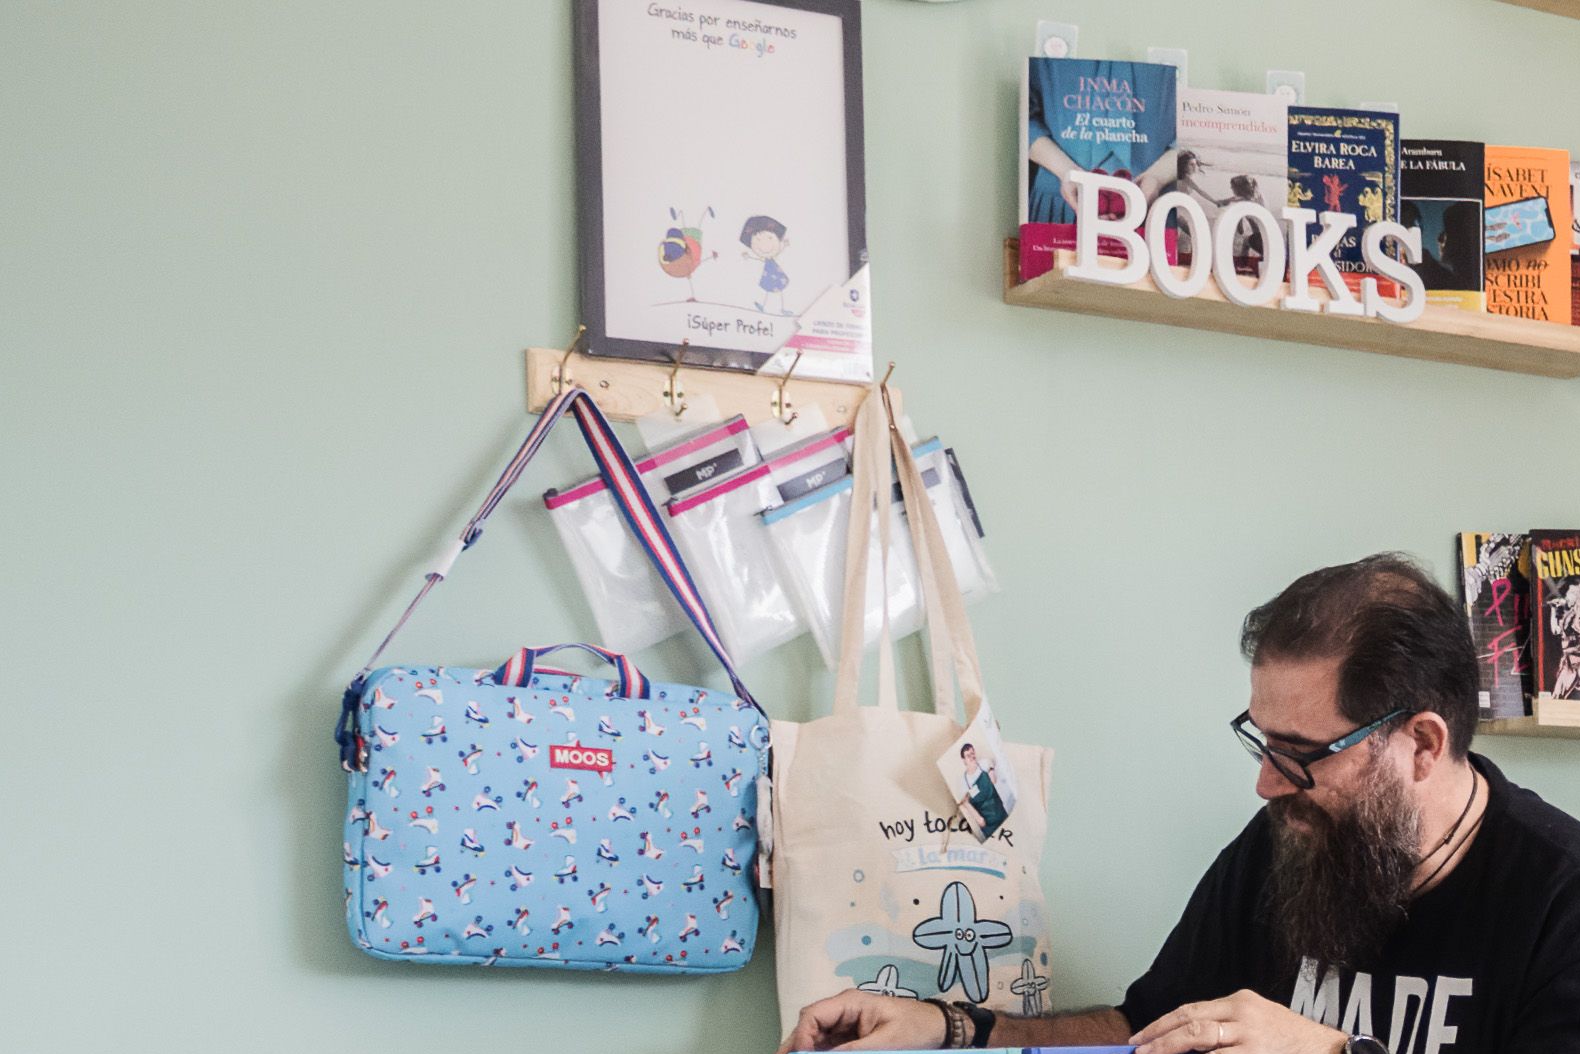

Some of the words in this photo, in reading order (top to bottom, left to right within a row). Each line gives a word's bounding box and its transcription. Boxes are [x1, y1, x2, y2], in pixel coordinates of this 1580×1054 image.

[647, 2, 695, 22] Gracias
[699, 14, 720, 31] por
[726, 19, 798, 40] enseñarnos
[671, 28, 698, 42] más
[702, 33, 724, 49] que
[1079, 76, 1132, 94] INMA
[1182, 102, 1214, 116] Pedro
[1074, 113, 1090, 127] El
[1091, 116, 1136, 129] cuarto
[1060, 124, 1078, 139] de
[1079, 123, 1094, 140] la
[1096, 125, 1149, 144] plancha
[1291, 140, 1336, 155] ELVIRA
[1340, 142, 1378, 158] ROCA
[1313, 156, 1356, 170] BAREA
[1410, 160, 1424, 169] LA
[1426, 159, 1466, 171] FÁBULA
[1062, 168, 1426, 325] BOOKS
[736, 318, 774, 337] Profe!
[555, 748, 609, 767] MOOS
[879, 817, 914, 842] hoy
